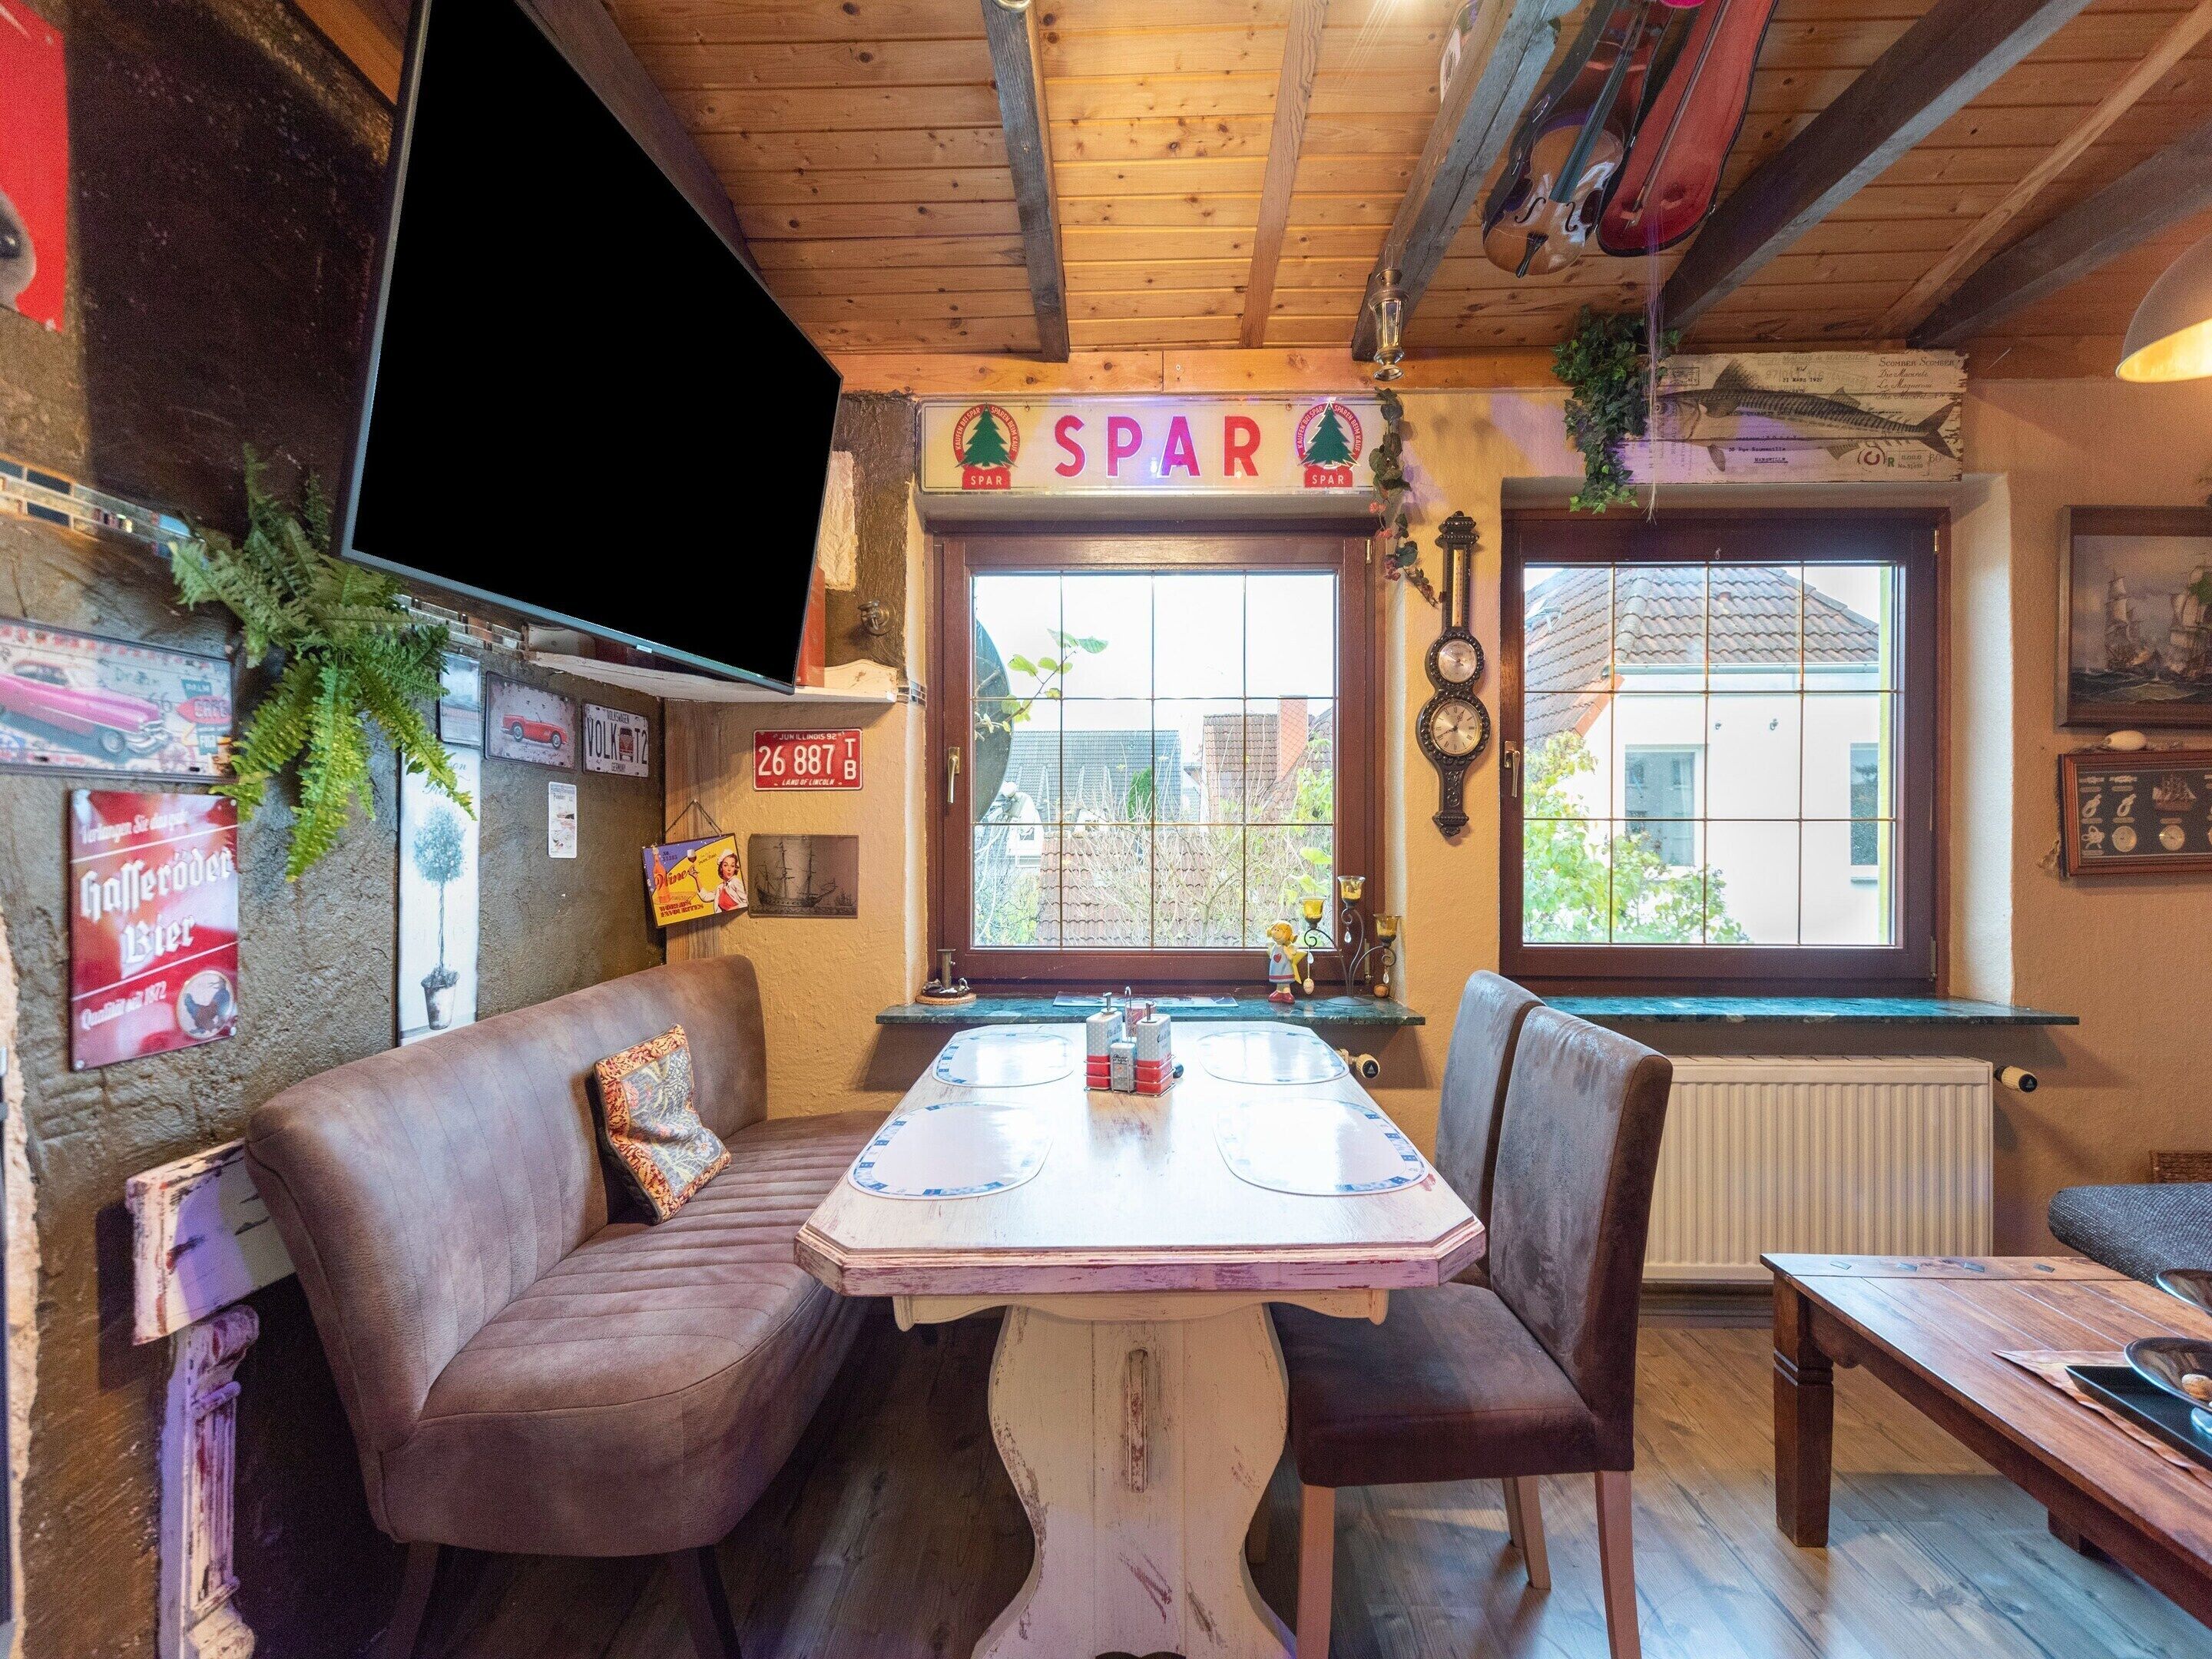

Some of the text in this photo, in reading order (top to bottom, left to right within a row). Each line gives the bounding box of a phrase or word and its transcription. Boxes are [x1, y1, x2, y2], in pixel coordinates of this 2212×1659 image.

[955, 407, 981, 450] KAUFEN BEI SPAR
[991, 406, 1010, 422] SPAREN
[1007, 420, 1018, 435] BEIM
[1297, 406, 1323, 449] KAUFEN BEI SPAR
[1334, 405, 1353, 420] SPAREN
[1350, 419, 1360, 435] BEIM
[1054, 414, 1261, 478] SPAR
[970, 475, 1002, 485] SPAR
[1312, 474, 1344, 485] SPAR
[587, 717, 647, 764] VOLK T2
[758, 744, 836, 776] 26 887
[124, 913, 195, 964] Bier
